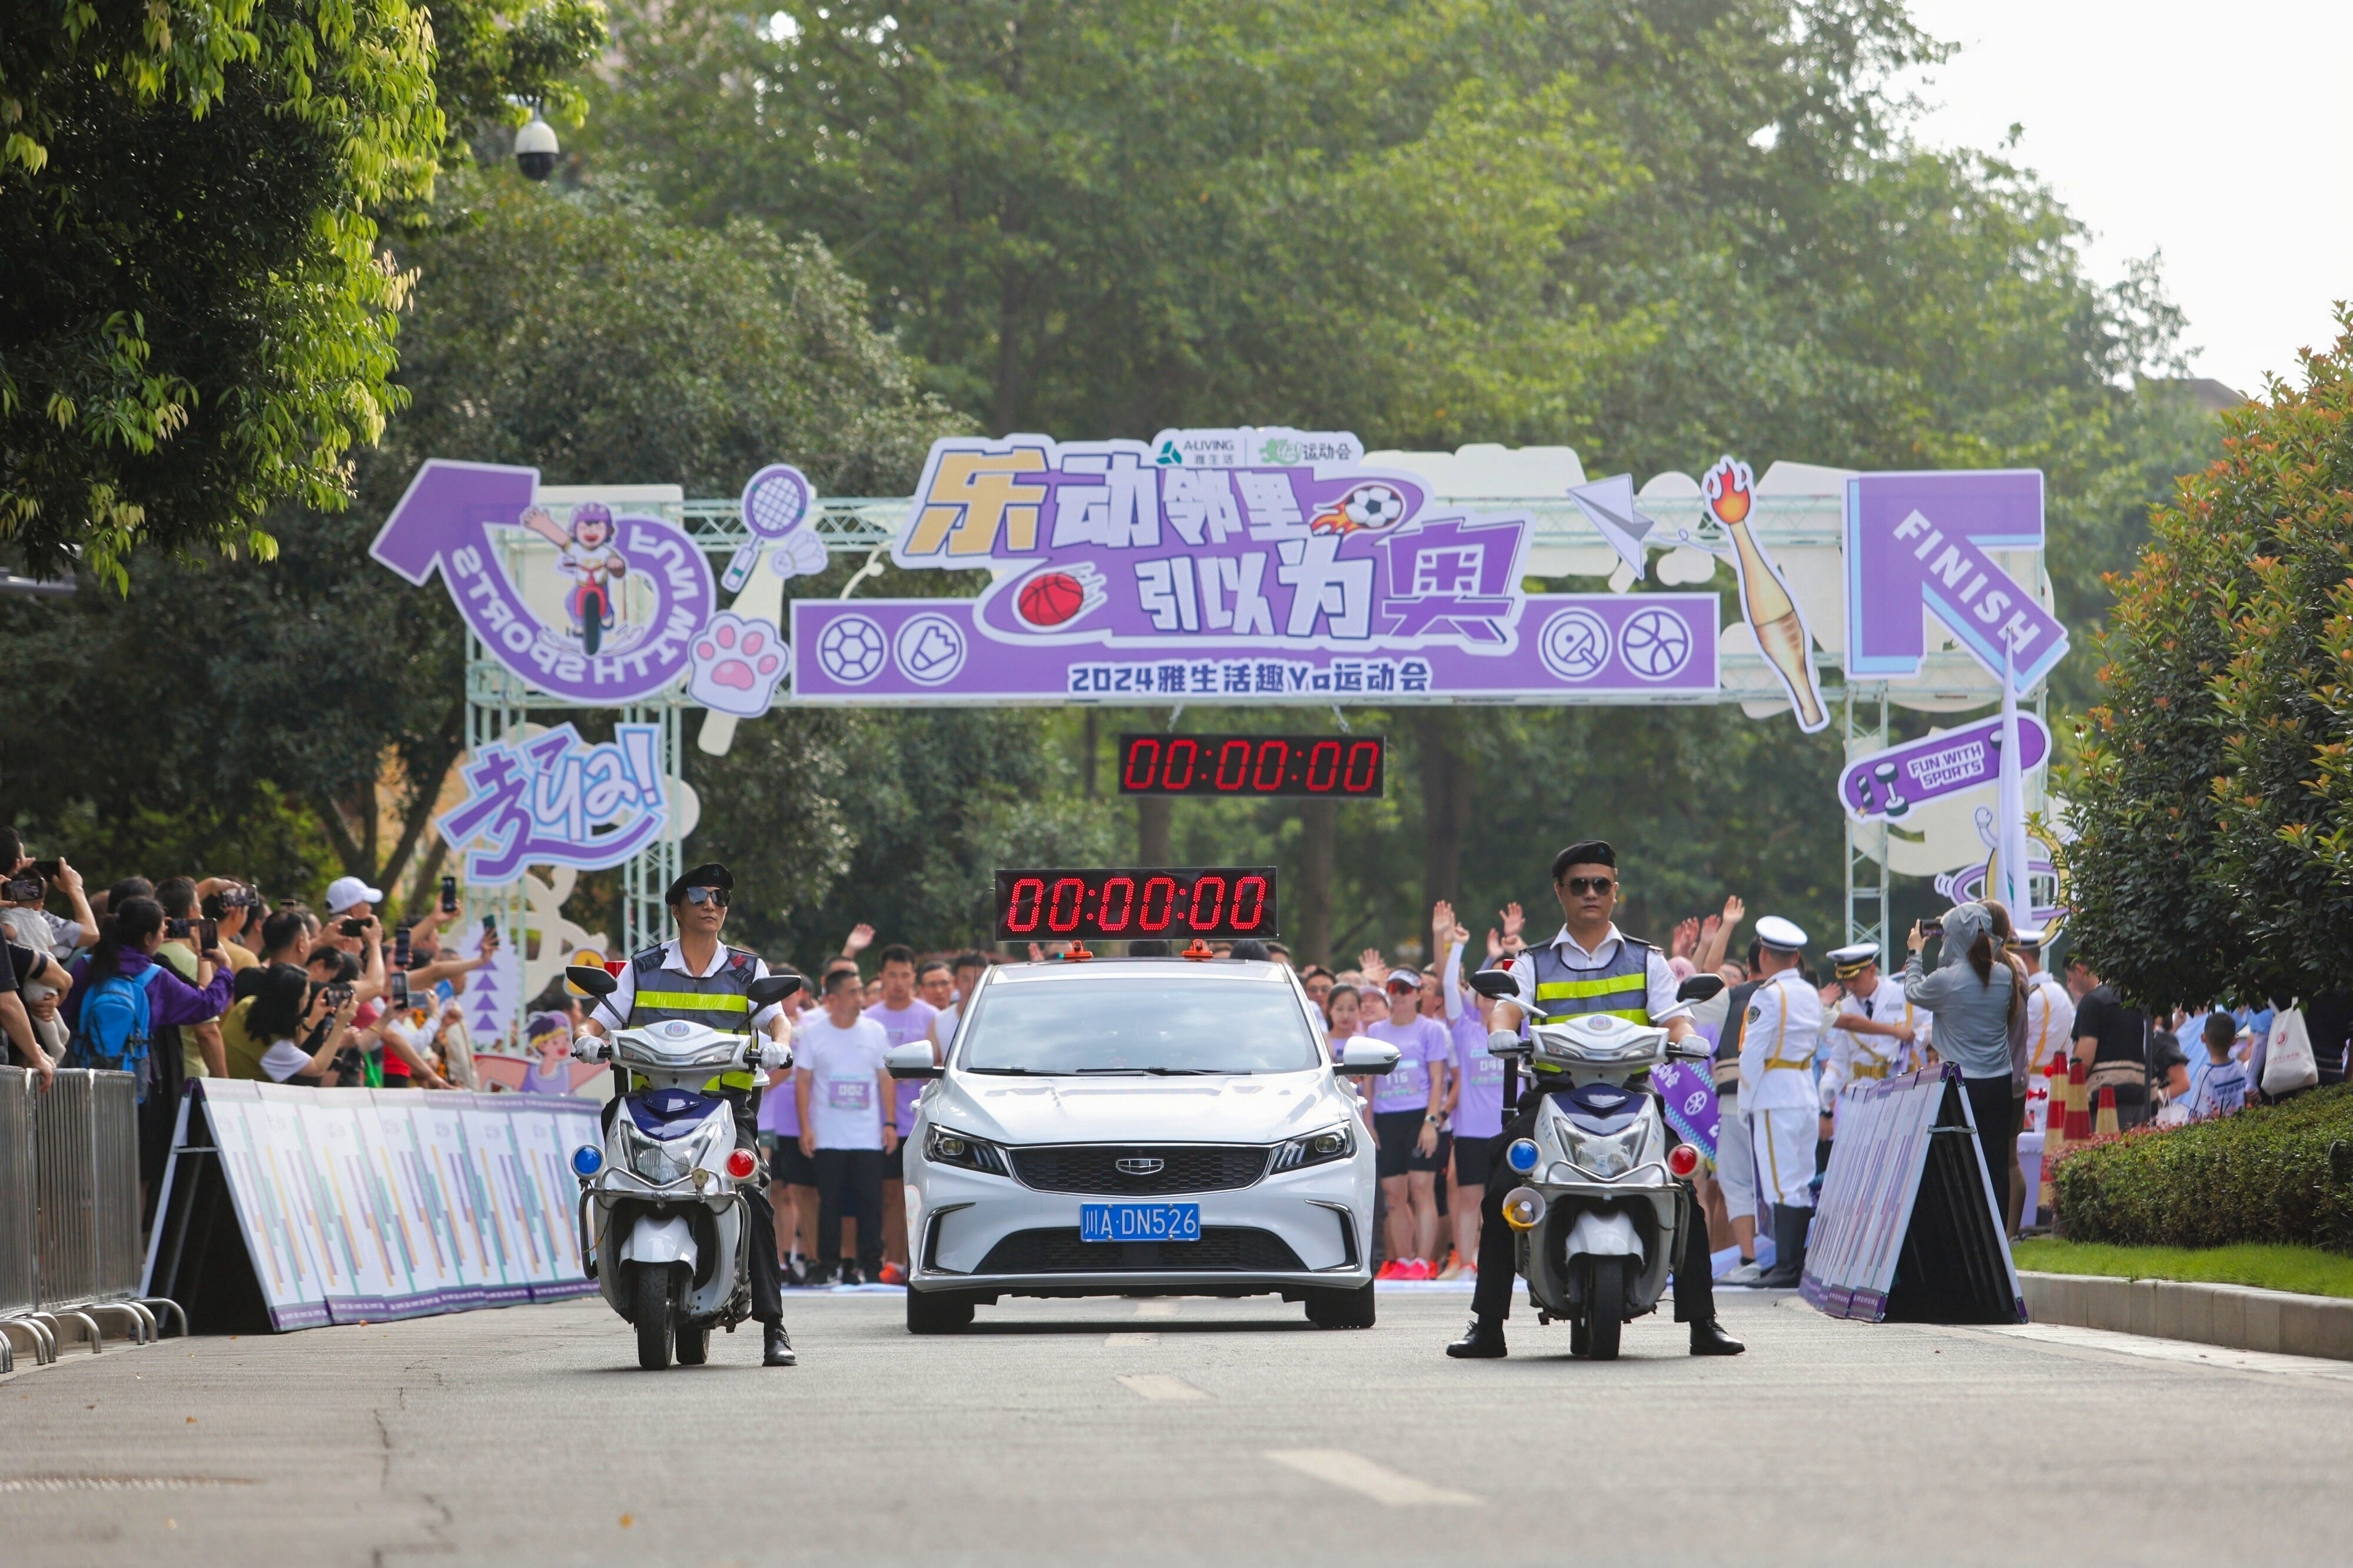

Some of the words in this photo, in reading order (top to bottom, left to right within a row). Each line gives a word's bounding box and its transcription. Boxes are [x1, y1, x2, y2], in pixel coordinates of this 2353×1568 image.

[1194, 454, 1234, 465] 雅生活
[903, 447, 1310, 556] 乐动邻里
[1892, 509, 2041, 655] FINISH
[1124, 739, 1379, 791] 00:00:00
[1910, 756, 1940, 775] FUN
[1943, 744, 1982, 765] WITH
[1923, 760, 1981, 786] SPORTS
[1007, 876, 1266, 931] 00:00:00
